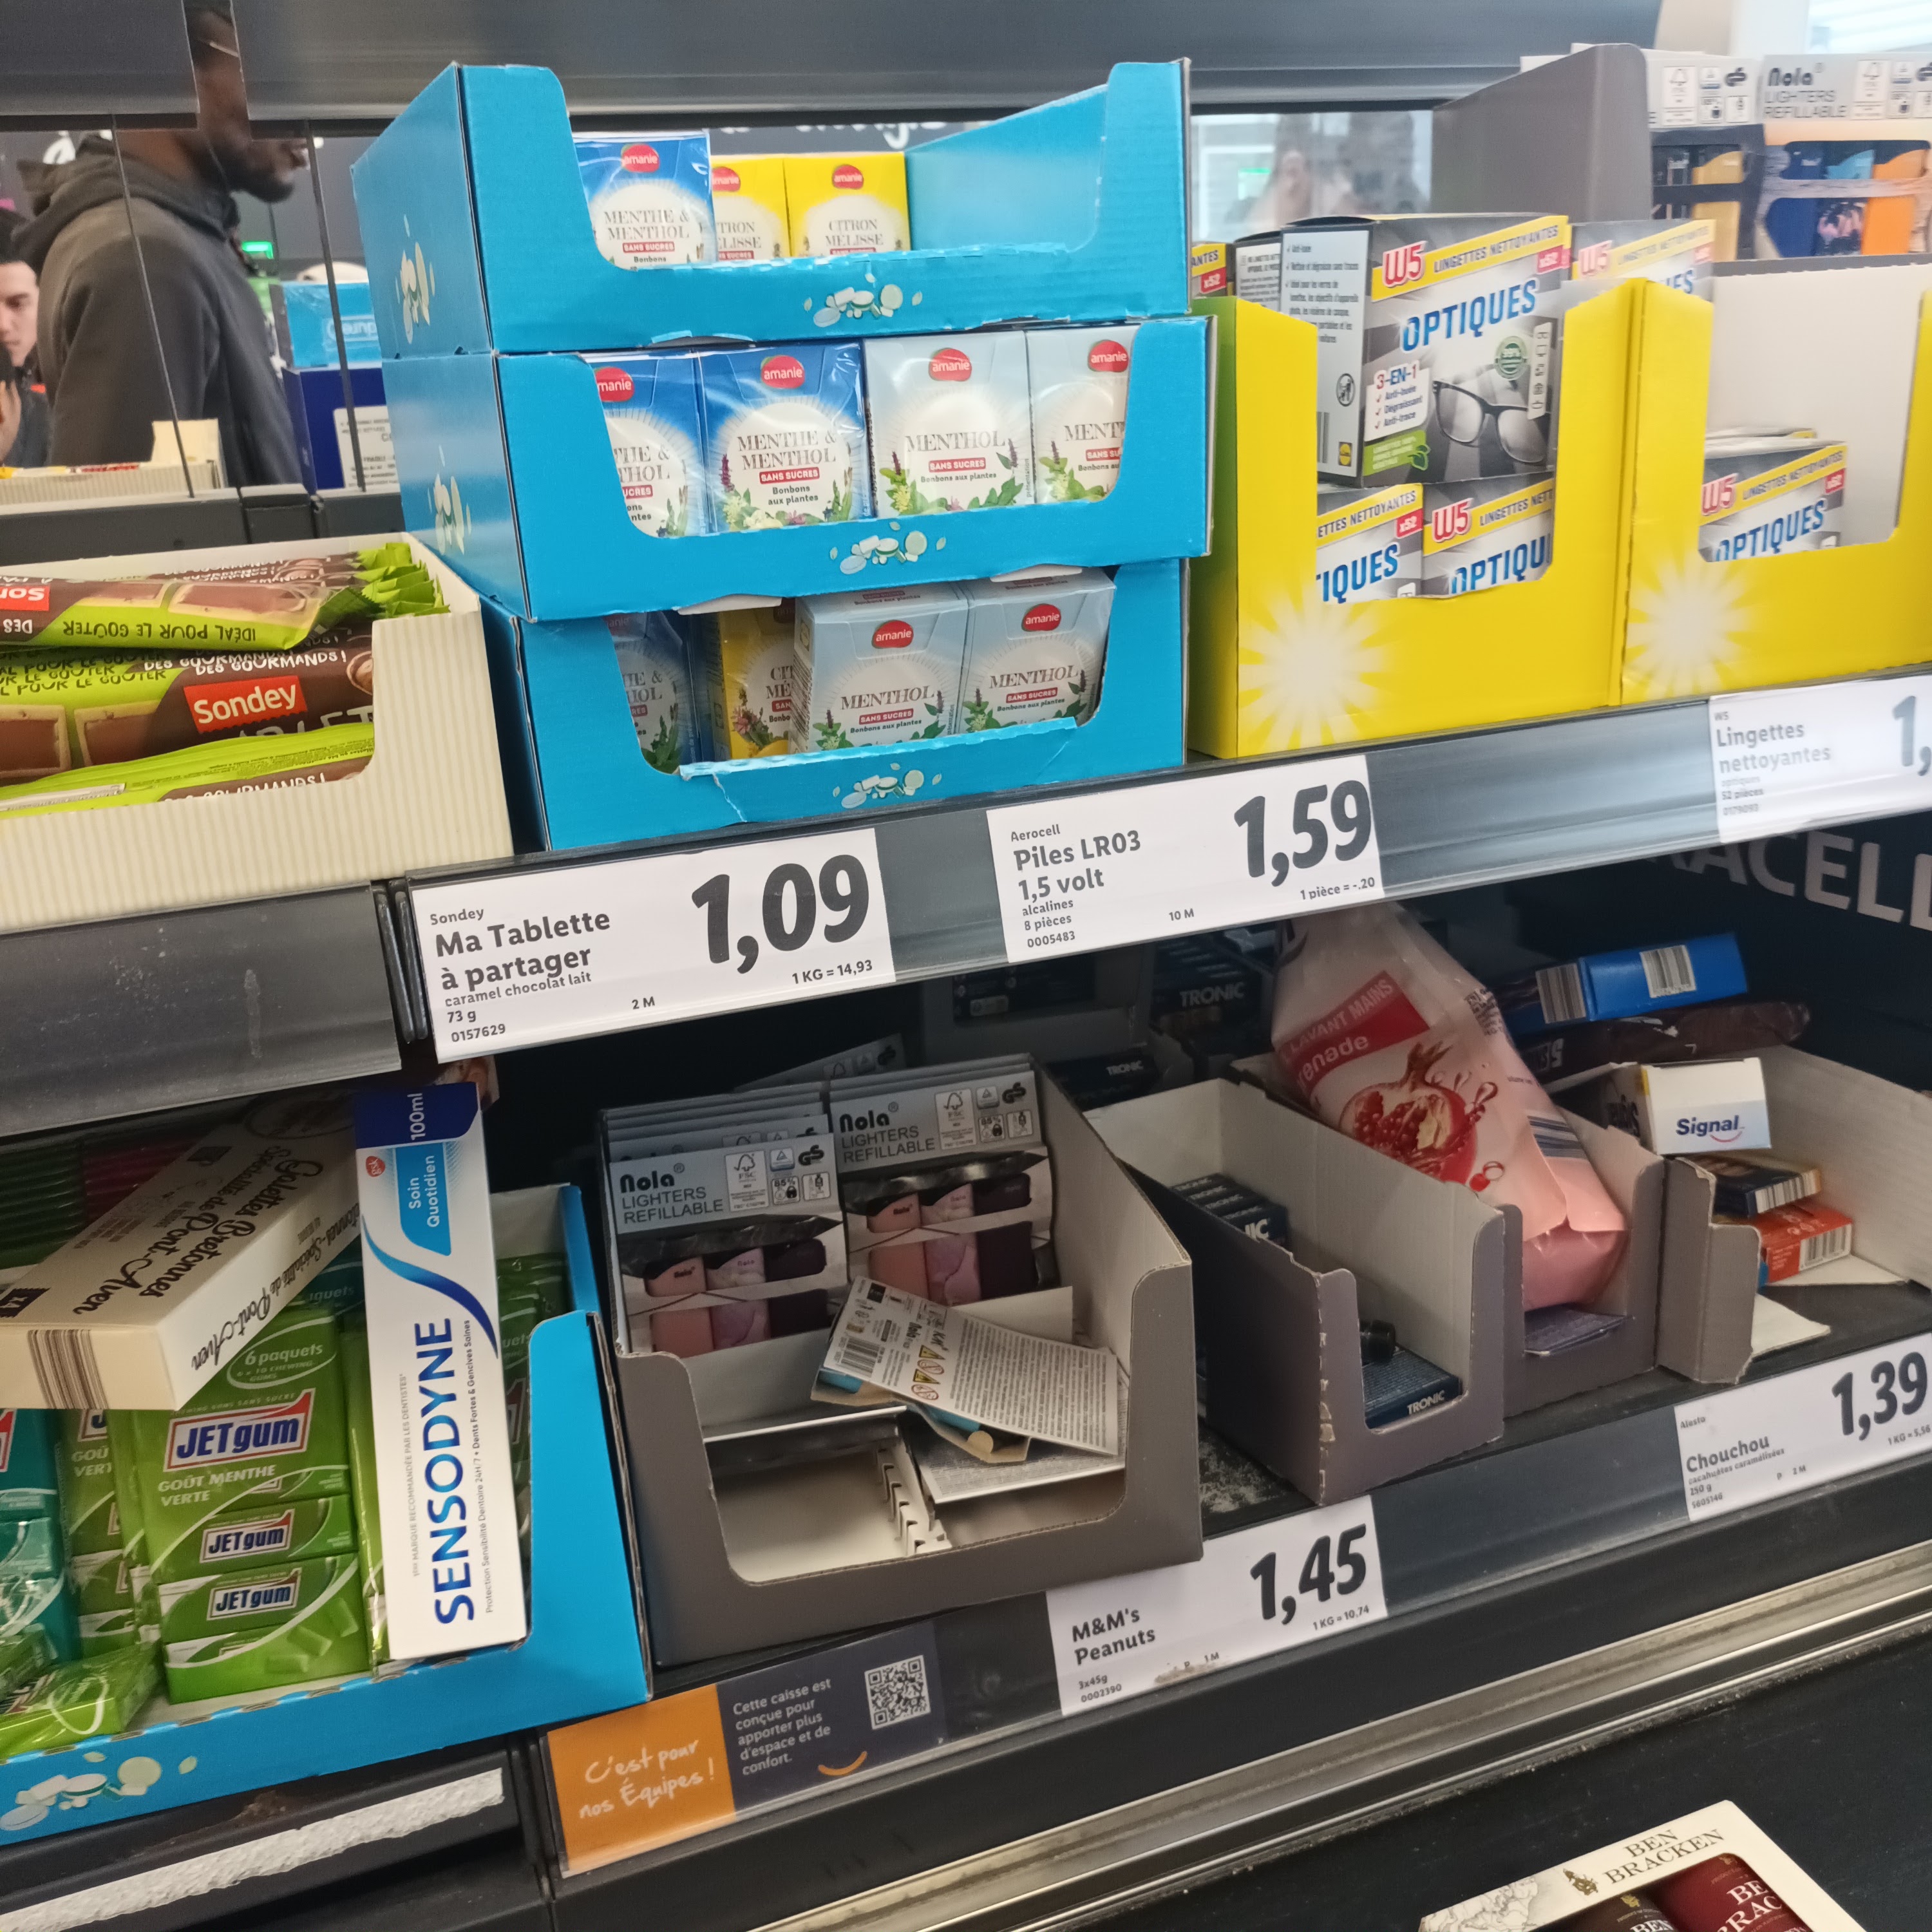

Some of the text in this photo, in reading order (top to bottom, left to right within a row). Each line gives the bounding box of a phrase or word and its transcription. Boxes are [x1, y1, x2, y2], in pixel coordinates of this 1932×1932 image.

[1763, 90, 1836, 104] LIGHTERS
[1763, 104, 1847, 119] REFILLABLE
[622, 154, 659, 165] amanie
[604, 210, 674, 225] MENTHE
[828, 219, 877, 231] CITRON
[607, 226, 690, 241] MENTHOL
[1383, 225, 1558, 287] W5 LINGETTES NETTOYANTES
[1402, 279, 1537, 353] OPTIQUES
[933, 360, 971, 373] amanie
[1090, 351, 1128, 365] amanie
[763, 366, 803, 379] amanie
[1376, 363, 1417, 390] 3-EN-1
[736, 430, 819, 453] MENTHE
[905, 430, 1006, 453] MENTHOL
[741, 448, 837, 471] MENTHOL
[929, 458, 985, 471] SANS SUCRES
[761, 469, 819, 482] SANS SUCRES
[920, 471, 998, 484] Bonbons aux plantes
[768, 493, 819, 506] aux plantes
[772, 485, 811, 495] Bonbons
[1702, 475, 1736, 515] W5
[1350, 490, 1416, 529] NETTOYANTES
[1433, 498, 1529, 542] W5 LINGETTES
[1715, 500, 1825, 562] OPTIQUES
[1025, 611, 1061, 625] amanie
[63, 620, 256, 643] IDÉAL POUR LE GOÛTER
[876, 629, 913, 643] amanie
[989, 664, 1081, 690] MENTHOL
[194, 684, 298, 724] Sondey
[841, 685, 934, 711] MENTHOL
[997, 697, 1066, 712] Bonbons aux plantes
[1007, 688, 1057, 703] SANS SUCRES
[849, 719, 923, 734] Bonbons aux plantes
[860, 710, 913, 724] SANS SUCRES
[1716, 723, 1806, 749] Lingettes
[1718, 746, 1832, 775] nettoyantes
[1010, 824, 1061, 843] Aerocell
[1233, 779, 1372, 887] 1,59
[1013, 829, 1142, 872] Piles LR03
[1018, 868, 1105, 904] 1,5 volt
[1300, 883, 1341, 901] 1 pièce
[430, 906, 485, 926] Sondey
[690, 853, 870, 975] 1,09
[1021, 899, 1074, 917] alcalines
[1168, 908, 1195, 922] 10 M
[435, 909, 611, 958] Ma Tablette
[1024, 913, 1073, 932] 8 pièces
[1027, 930, 1077, 949] 0005483
[441, 946, 592, 993] à partager
[791, 959, 874, 986] 1 KG 14,93
[444, 971, 592, 1009] caramel chocolat lait
[631, 996, 656, 1010] 2 M
[1179, 983, 1245, 1008] TRONIC
[447, 1009, 477, 1025] 73 g
[1290, 978, 1394, 1052] LAVANT MAINS
[450, 1023, 507, 1044] 0157629
[1106, 1060, 1145, 1077] TRONIC
[1296, 1035, 1370, 1086] renade
[407, 1092, 426, 1141] 100ml
[838, 1110, 890, 1134] nola
[1676, 1115, 1740, 1139] Signal
[841, 1125, 920, 1150] LIGHTERS
[843, 1137, 936, 1164] REFILLABLE
[234, 1159, 323, 1216] Galettes
[408, 1177, 422, 1209] Soin
[426, 1155, 440, 1228] Quotidien
[620, 1170, 676, 1193] nola
[622, 1186, 707, 1210] LIGHTERS
[623, 1198, 724, 1225] REFILLABLE
[72, 1212, 220, 1315] Pont-Aven
[138, 1219, 256, 1298] Bretonnes
[191, 1286, 272, 1372] Pont-Aven
[245, 1343, 323, 1365] 6 paquets
[1406, 1390, 1445, 1415] TRONIC
[1831, 1351, 1928, 1441] 1,39
[176, 1417, 299, 1459] JETgum
[463, 1320, 494, 1614] Protection Sensibilité Dentaire 24H/7 Dents Fortes Gencives Saines
[1686, 1435, 1770, 1473] Chouchou
[158, 1464, 278, 1493] GOÛT MENTHE
[413, 1318, 474, 1625] SENSODYNE
[161, 1490, 211, 1507] VERTE
[402, 1421, 419, 1560] MARQUE RECOMMANDÉE PAR LES
[208, 1528, 285, 1555] JETgum
[1250, 1523, 1367, 1625] 1,45
[215, 1586, 291, 1612] JETgum
[1072, 1607, 1141, 1643] M&M's
[1319, 1604, 1370, 1629] KG 10,74
[1075, 1628, 1156, 1666] Peanuts
[1078, 1674, 1108, 1690] 3x45g
[1081, 1683, 1122, 1703] 0002390
[732, 1678, 832, 1716] Cette caisse est
[735, 1698, 816, 1731] conçue pour
[737, 1712, 824, 1748] apporter plus
[739, 1723, 831, 1762] d'espace et de
[584, 1739, 700, 1785] C'est pour
[741, 1752, 793, 1777] confort.
[579, 1772, 703, 1819] nos Équipes
[1602, 1828, 1727, 1884] BRACKEN
[1622, 1829, 1680, 1859] BEN
